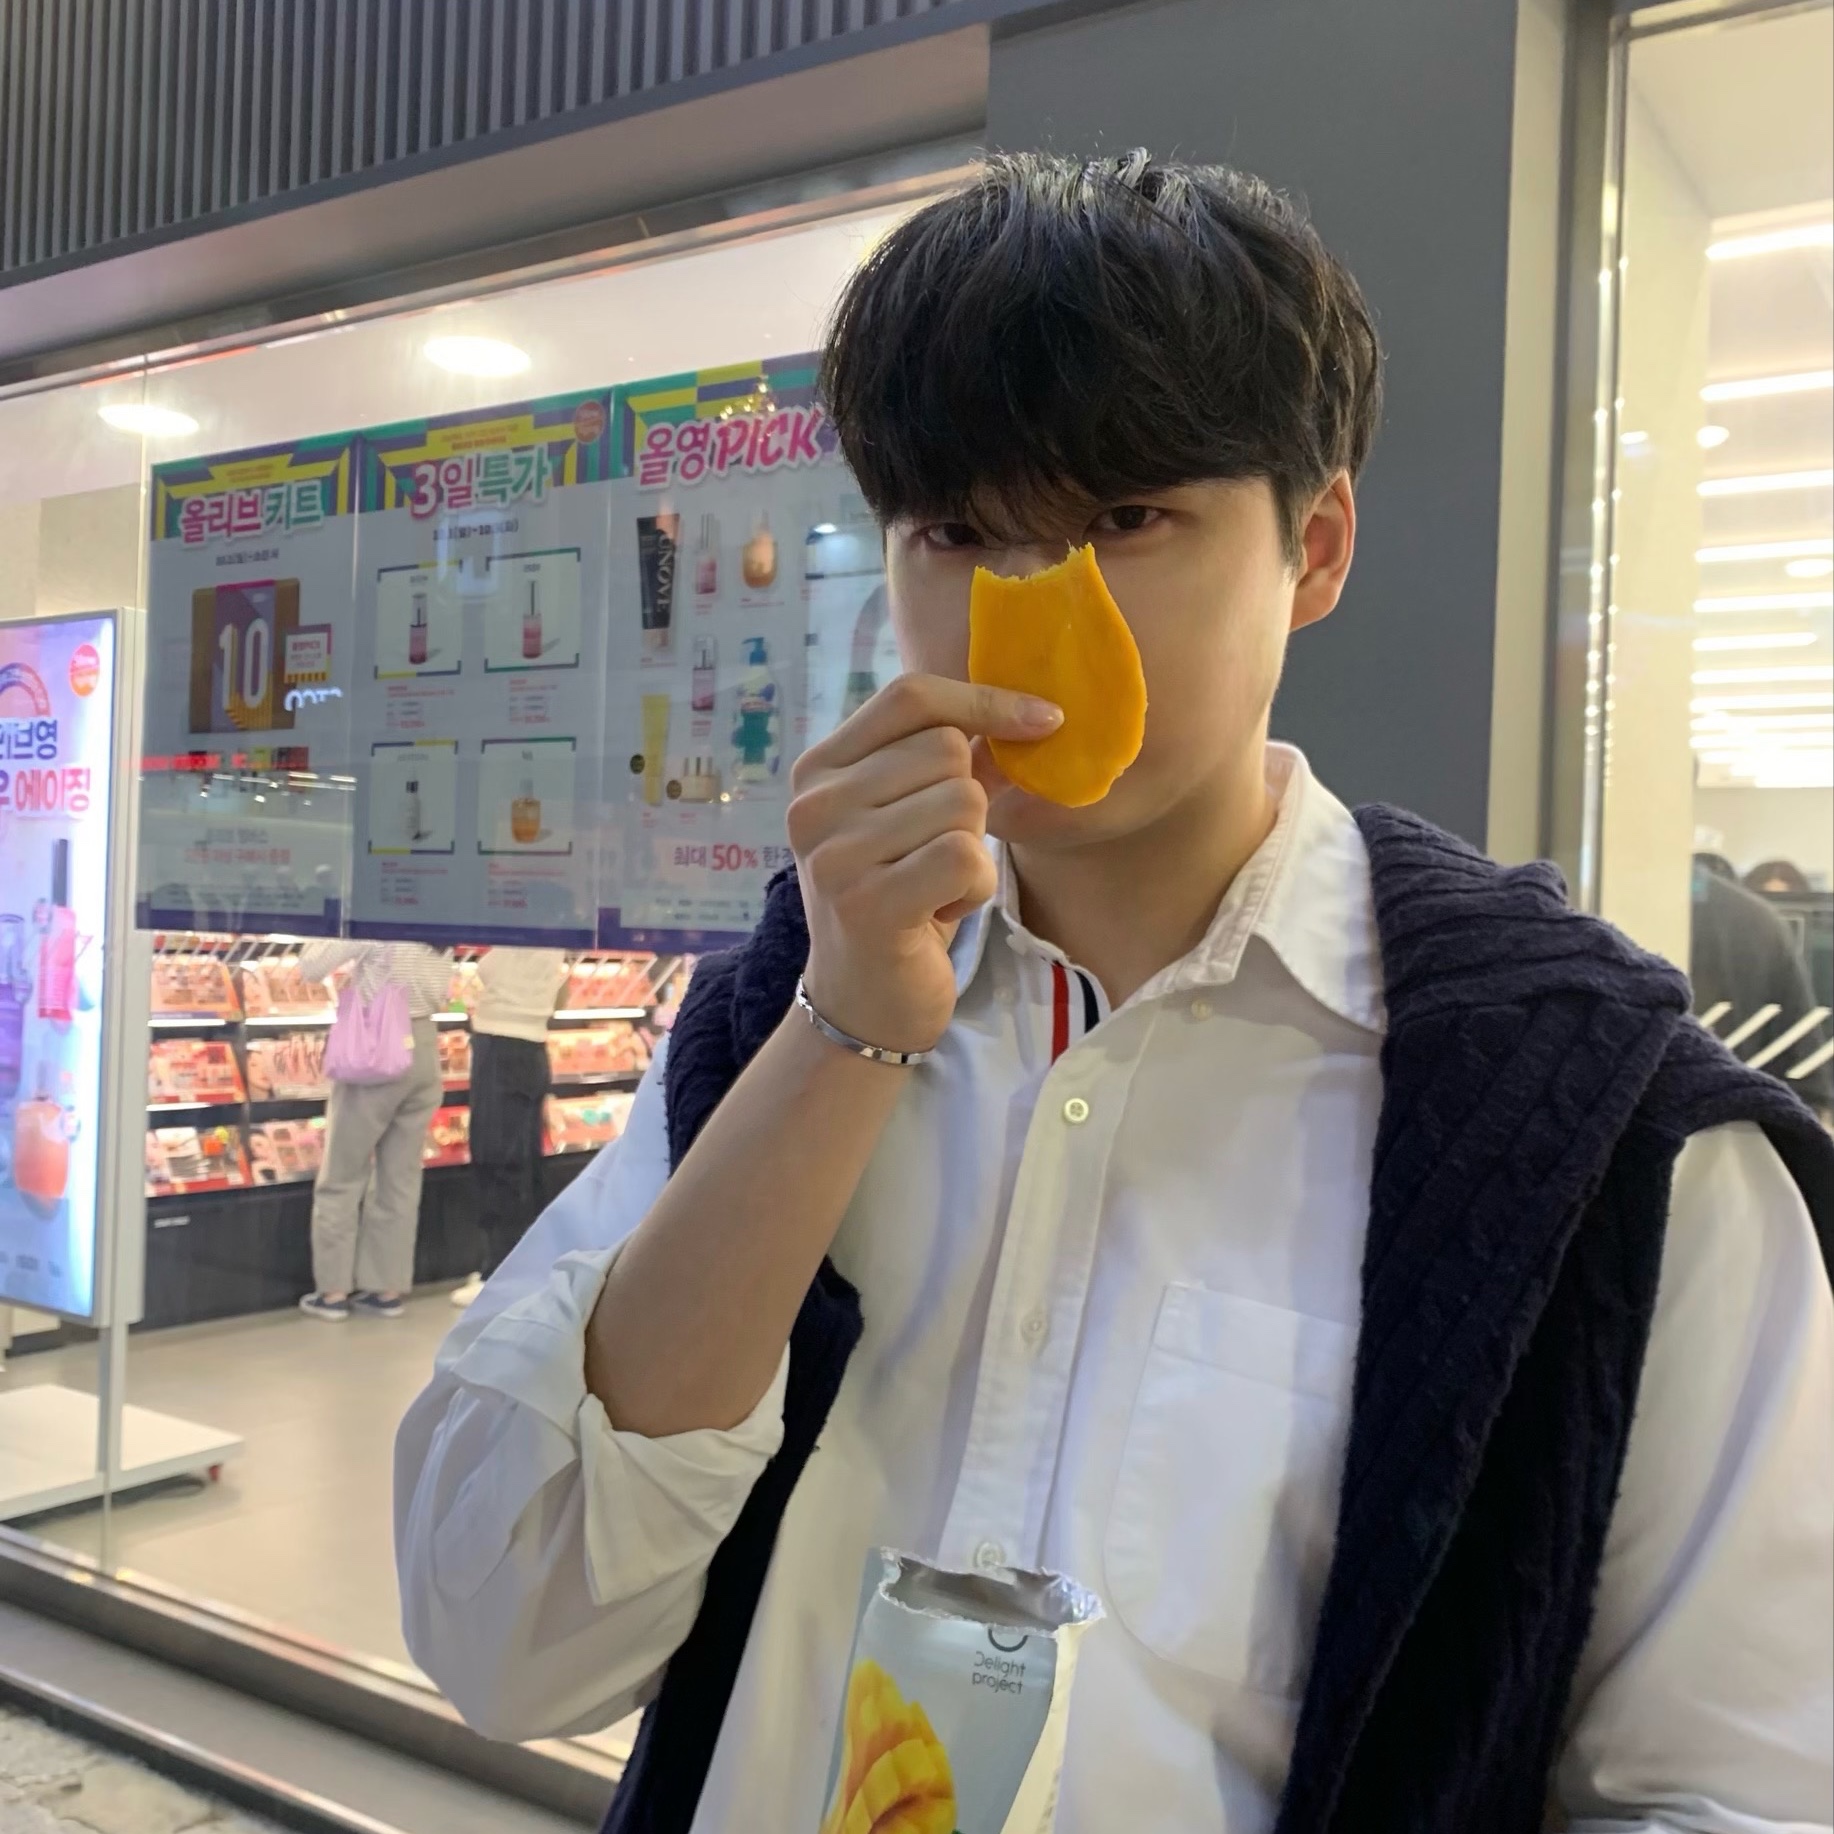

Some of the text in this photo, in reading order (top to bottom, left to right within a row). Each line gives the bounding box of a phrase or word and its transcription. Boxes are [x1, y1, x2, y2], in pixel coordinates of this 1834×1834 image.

[410, 444, 549, 519] 3일특가
[181, 482, 322, 545] 올리브키트
[674, 846, 707, 868] 최대
[711, 843, 758, 871] 50%
[974, 1651, 1026, 1677] Delight
[972, 1672, 1023, 1695] project
